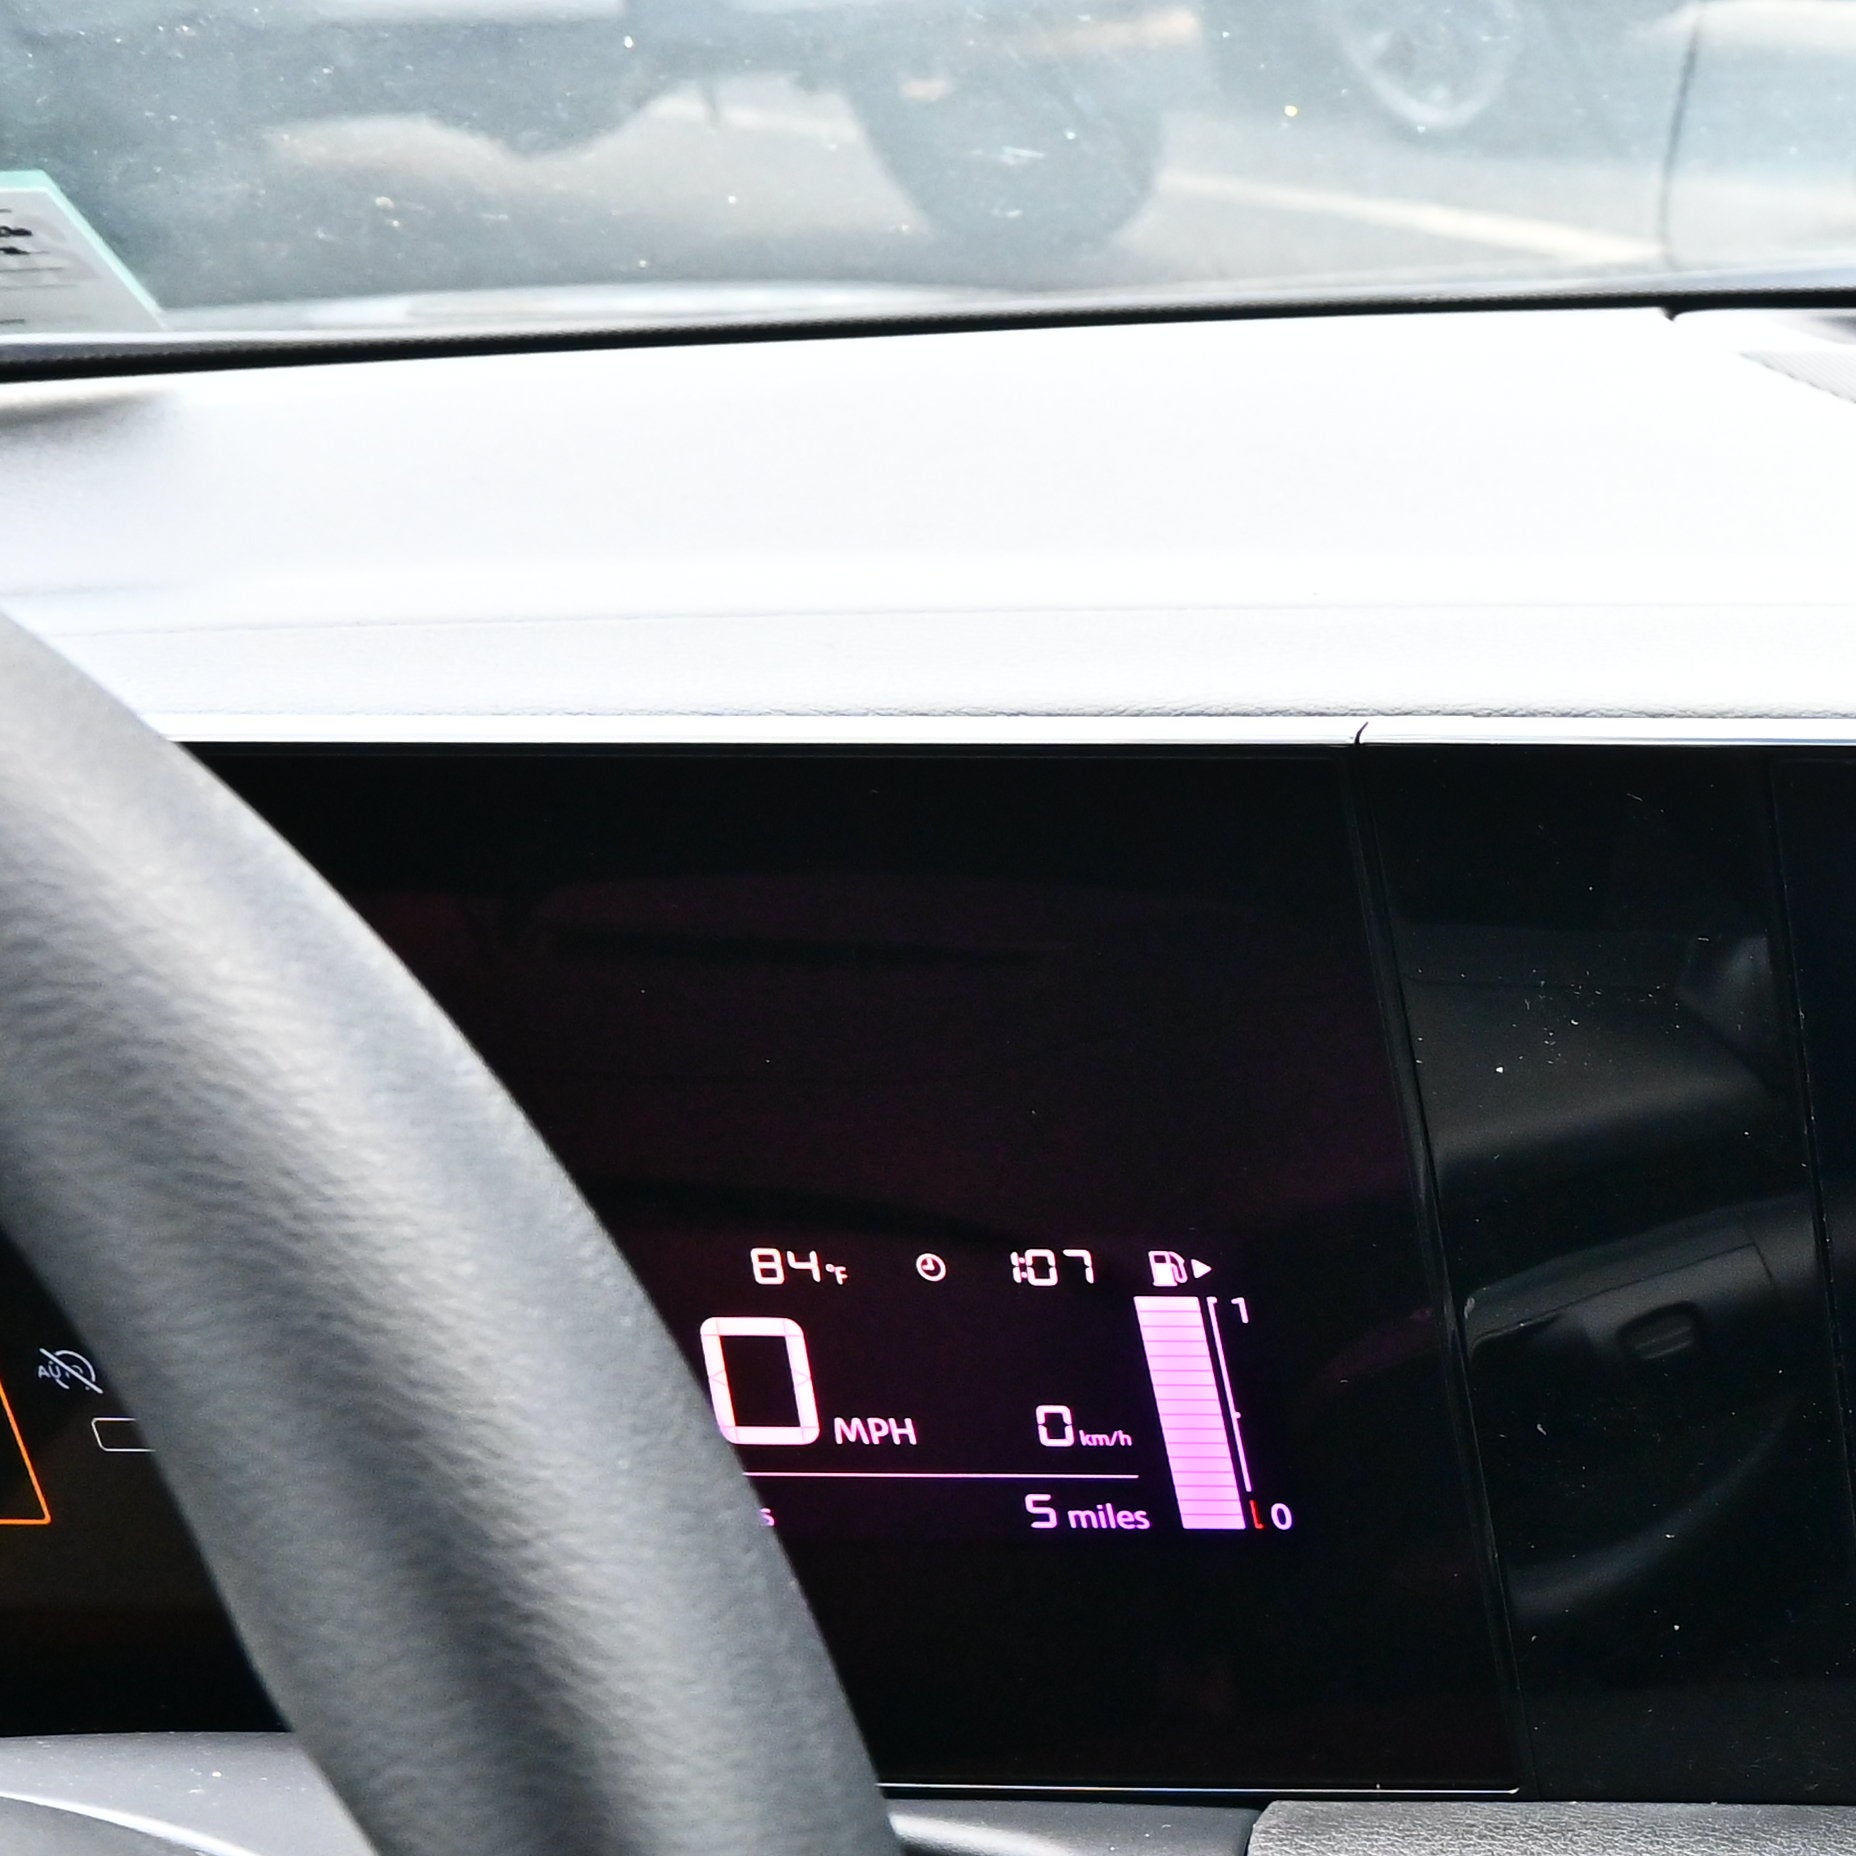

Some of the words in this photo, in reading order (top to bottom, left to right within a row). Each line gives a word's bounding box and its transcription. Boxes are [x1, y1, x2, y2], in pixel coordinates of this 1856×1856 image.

[1010, 1248, 1095, 1287] 1:07
[1231, 1297, 1249, 1324] 1
[700, 1316, 821, 1446] 0
[833, 1416, 918, 1446] MPH
[1079, 1428, 1133, 1447] km/h
[1025, 1493, 1059, 1529] 5
[1067, 1502, 1151, 1530] miles
[1270, 1502, 1293, 1531] 0
